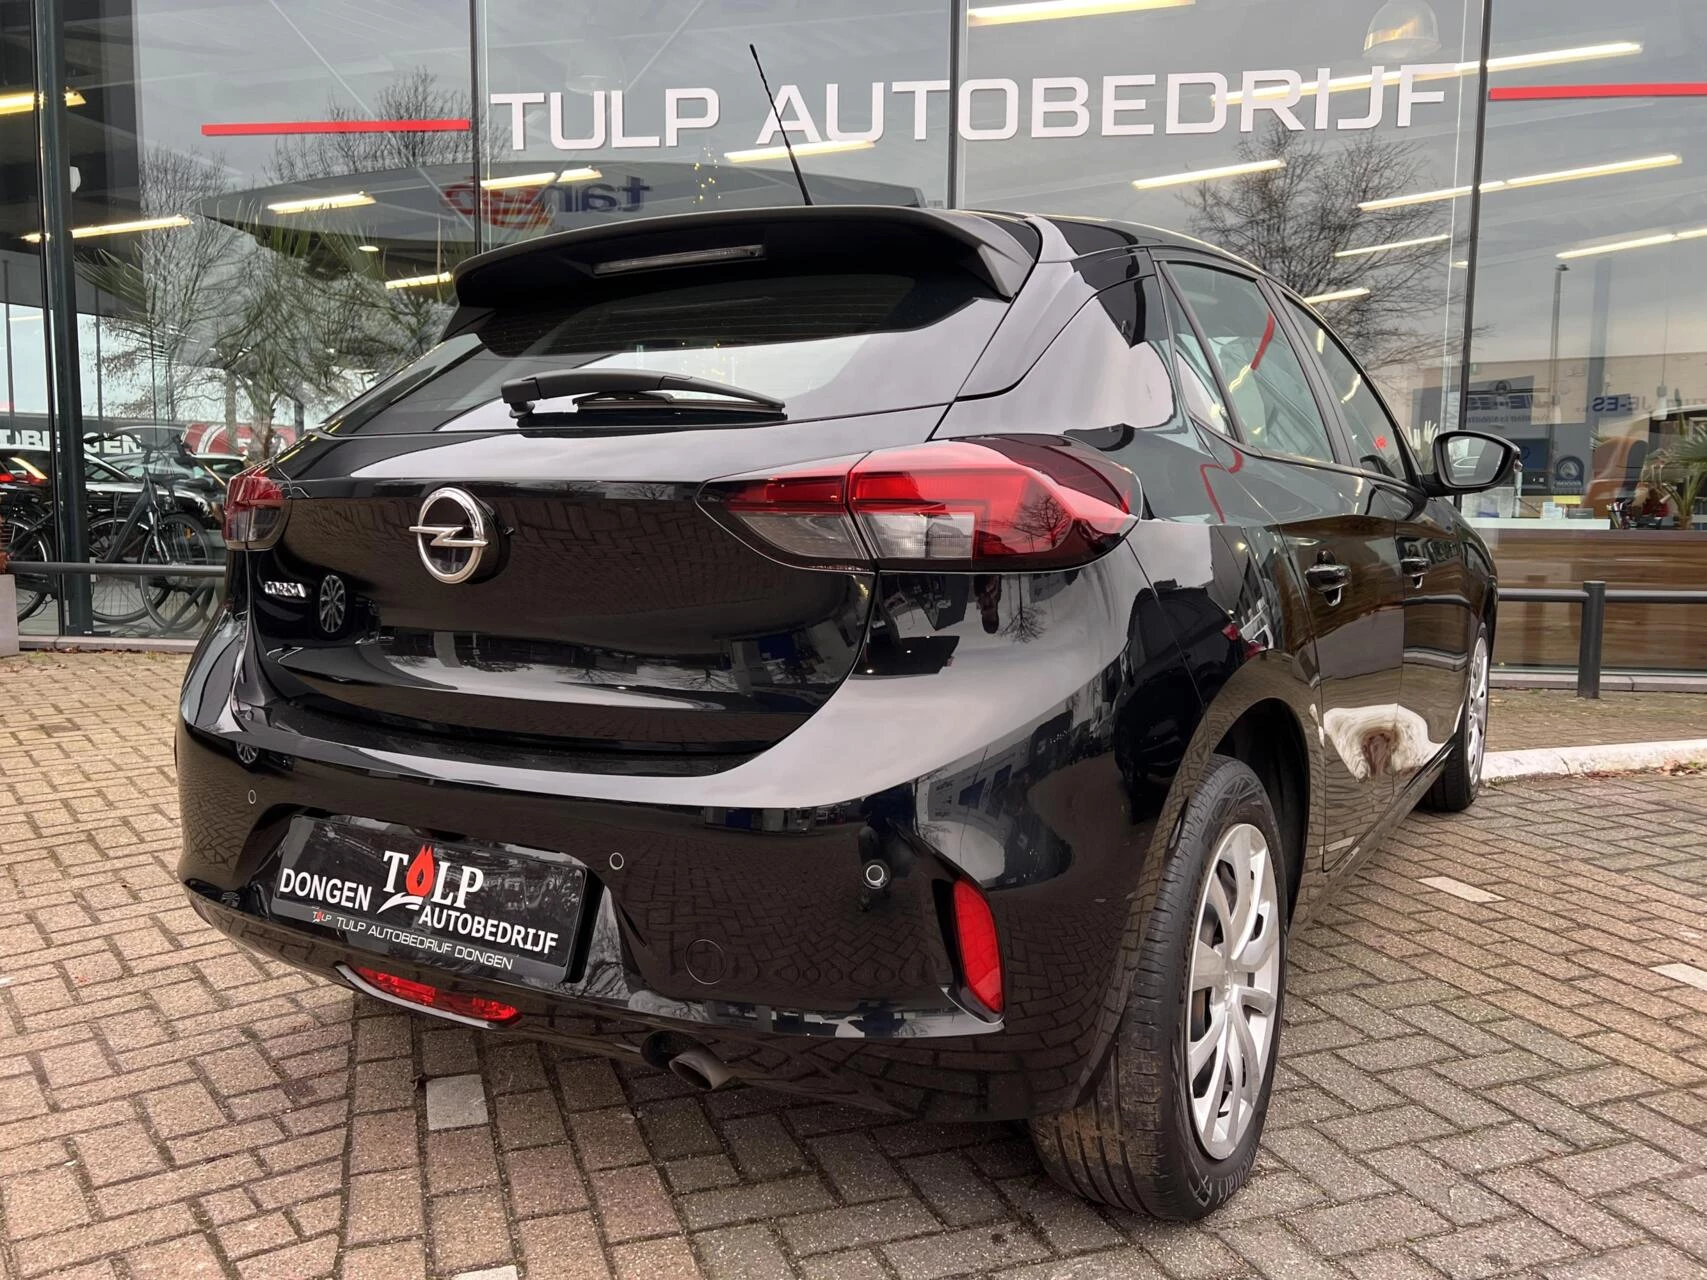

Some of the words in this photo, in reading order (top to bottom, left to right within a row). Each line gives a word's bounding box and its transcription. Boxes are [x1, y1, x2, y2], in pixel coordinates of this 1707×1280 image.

[490, 87, 719, 150] TULP
[756, 63, 1455, 146] AUTOBEDRIJF
[279, 868, 373, 911] DONGEN
[337, 917, 366, 932] TULP
[368, 925, 452, 954] AUTOBEDRIJF
[455, 946, 513, 970] DONGEN
[419, 905, 559, 954] AUTOBEDRIJF
